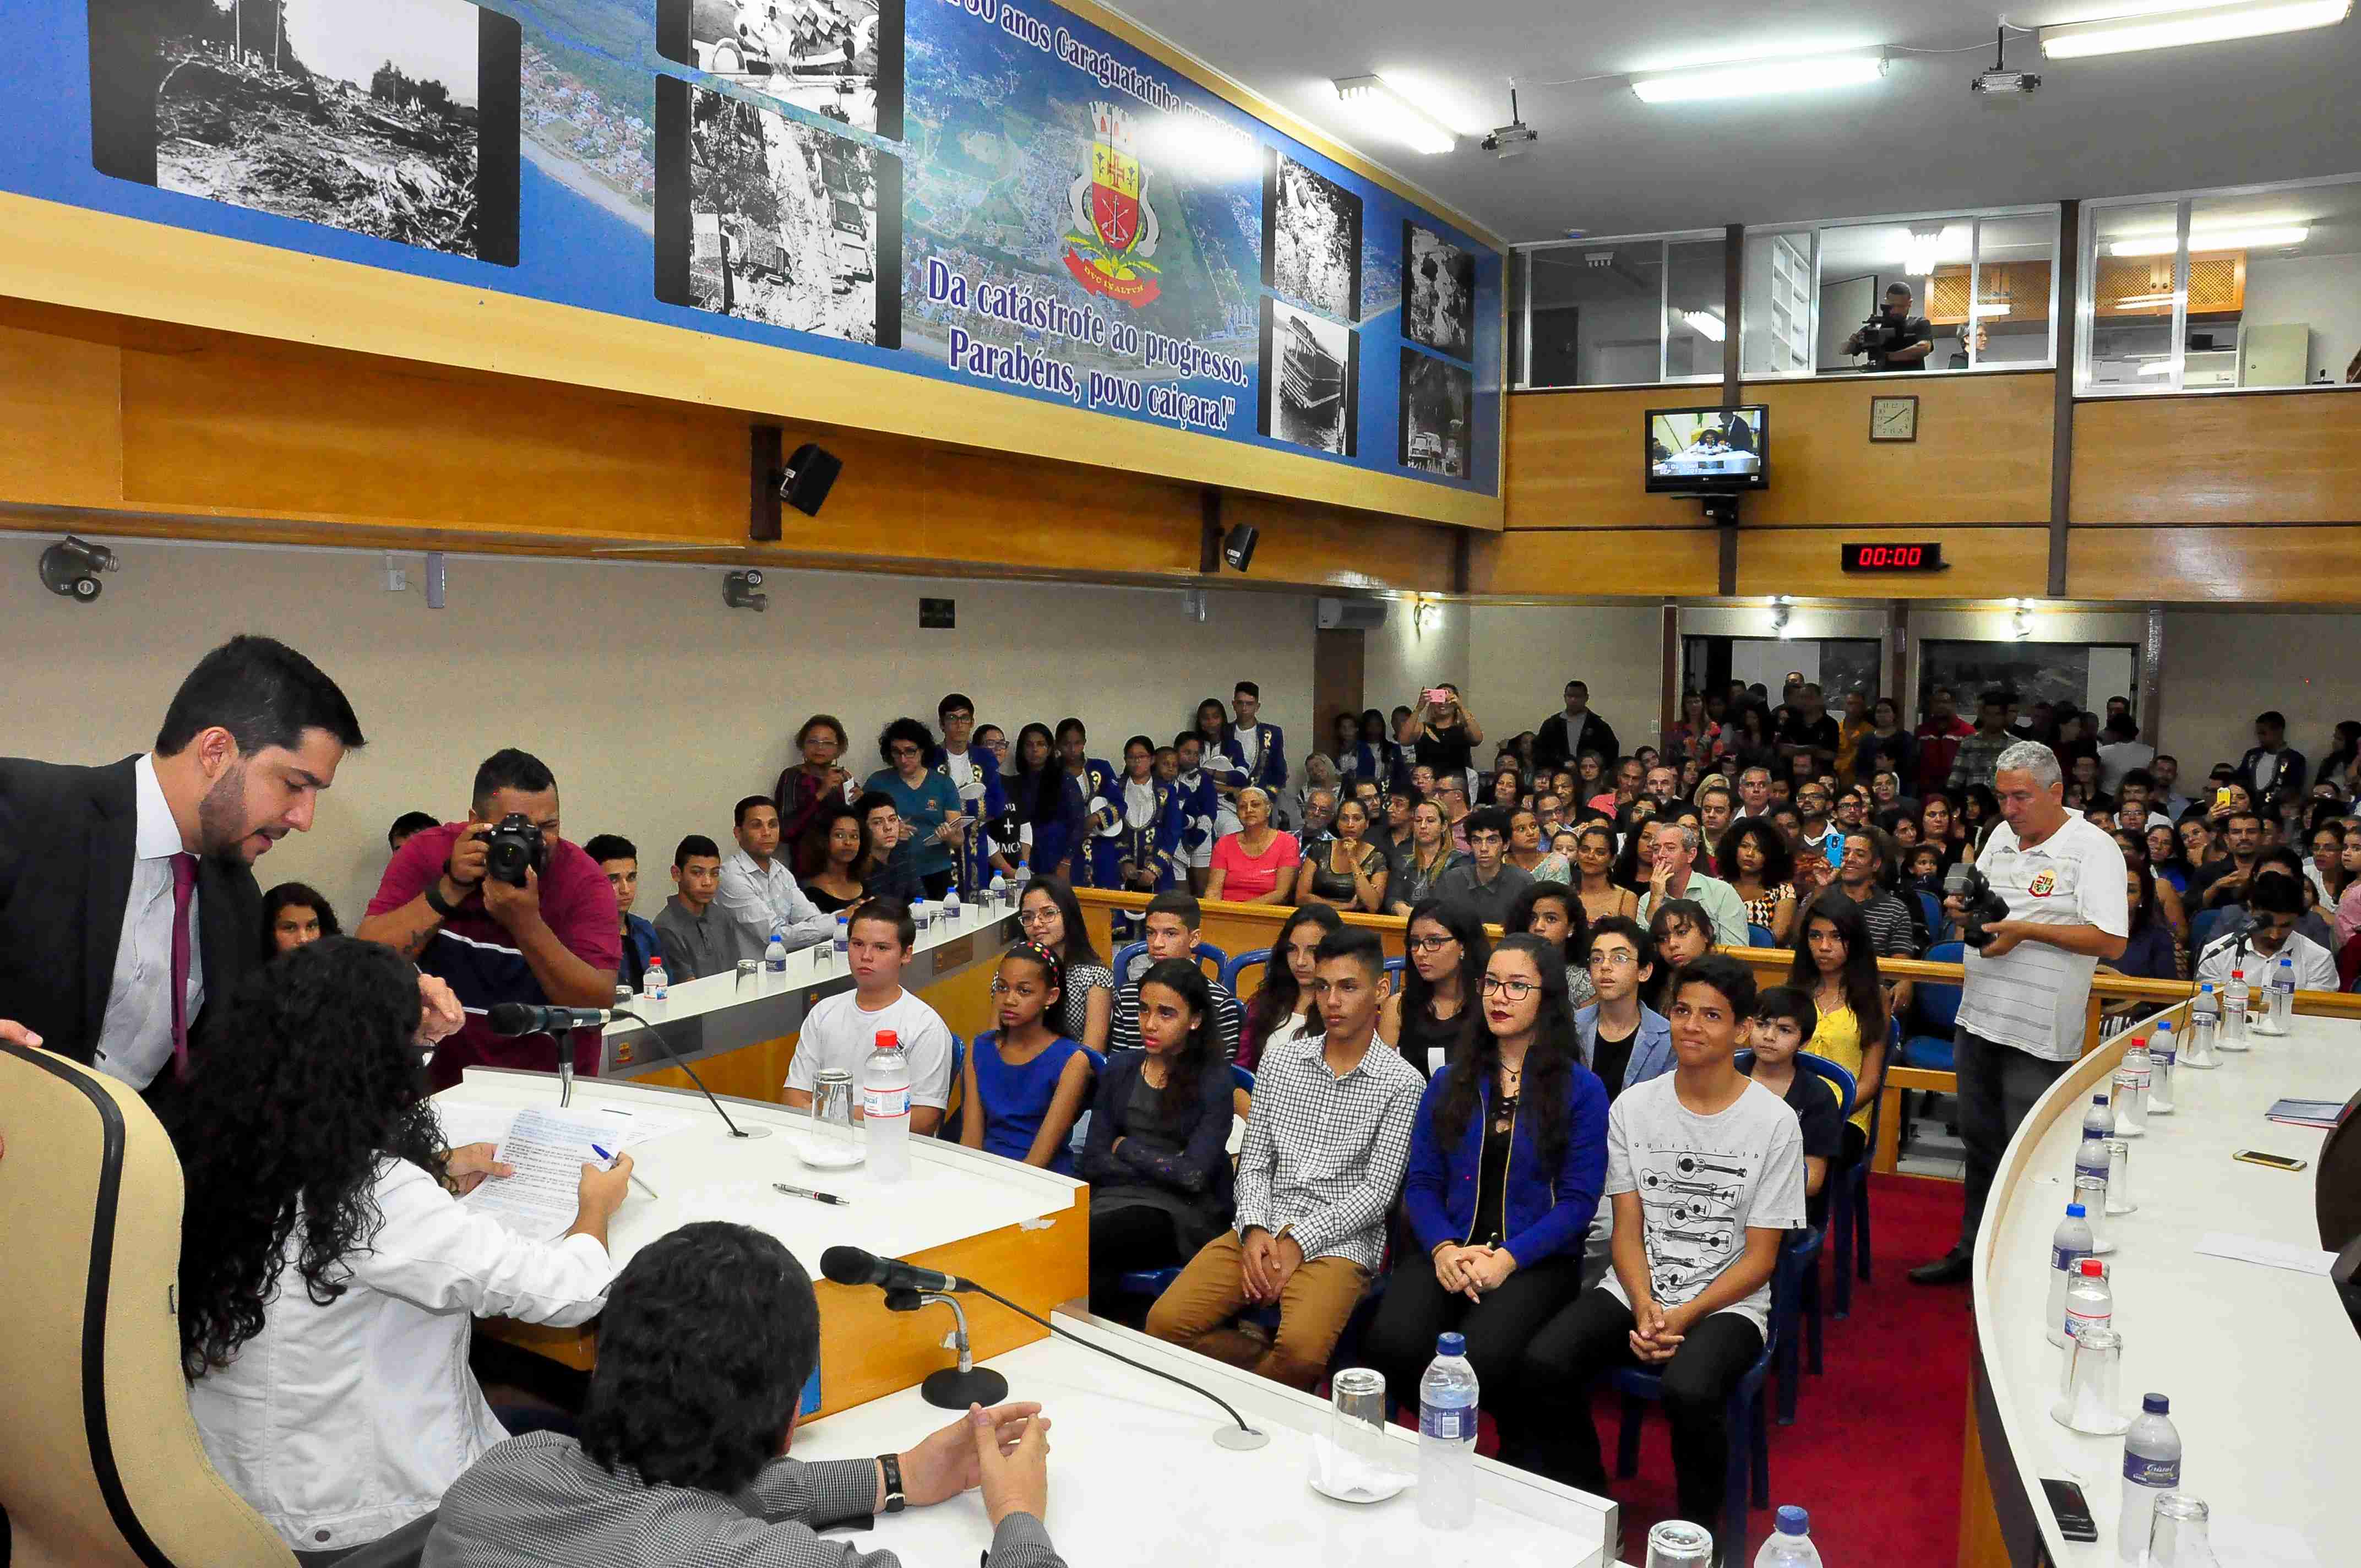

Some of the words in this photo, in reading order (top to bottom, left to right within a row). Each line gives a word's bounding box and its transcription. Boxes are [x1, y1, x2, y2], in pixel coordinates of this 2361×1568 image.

[1001, 4, 1050, 51] anos
[1056, 28, 1180, 112] Caraguatatuba
[928, 257, 967, 308] Da
[977, 281, 1105, 344] catástrofe
[1112, 325, 1137, 354] ao
[1145, 330, 1248, 386] progresso.
[949, 326, 1081, 408] Parabéns,
[1089, 370, 1141, 410] povo
[1148, 383, 1236, 430] caiçara!"
[1859, 548, 1921, 565] 00:00
